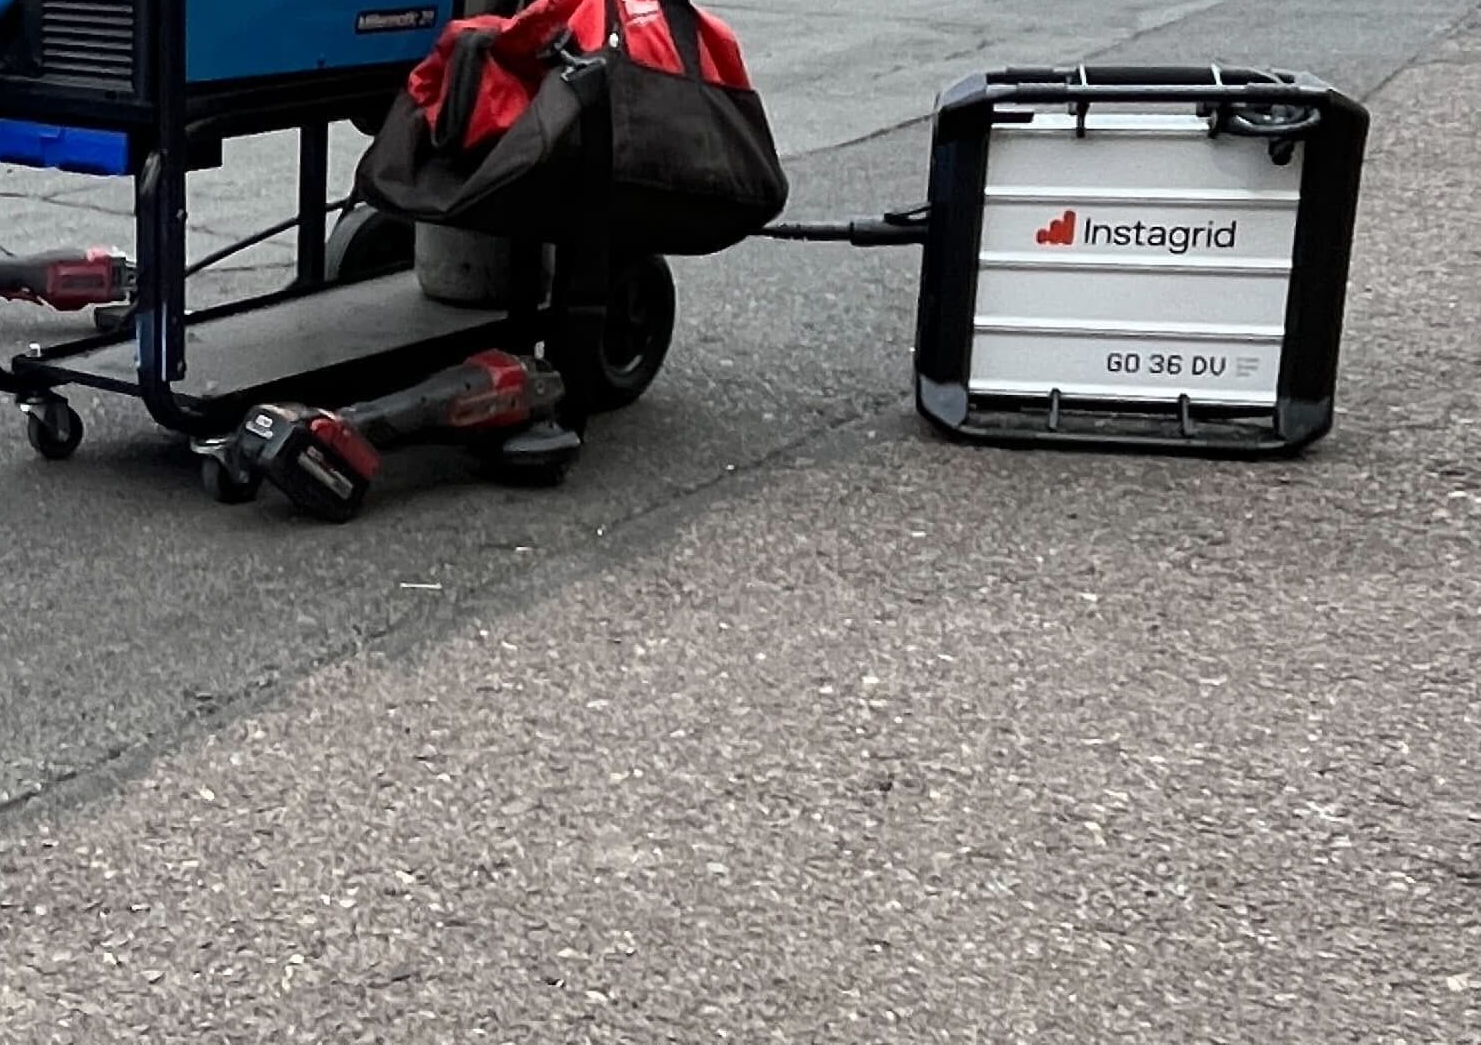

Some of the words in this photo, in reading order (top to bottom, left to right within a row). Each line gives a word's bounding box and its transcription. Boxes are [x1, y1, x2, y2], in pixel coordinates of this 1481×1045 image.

[1083, 217, 1237, 254] Instagrid
[1106, 352, 1141, 374] GO
[1148, 353, 1184, 376] 36
